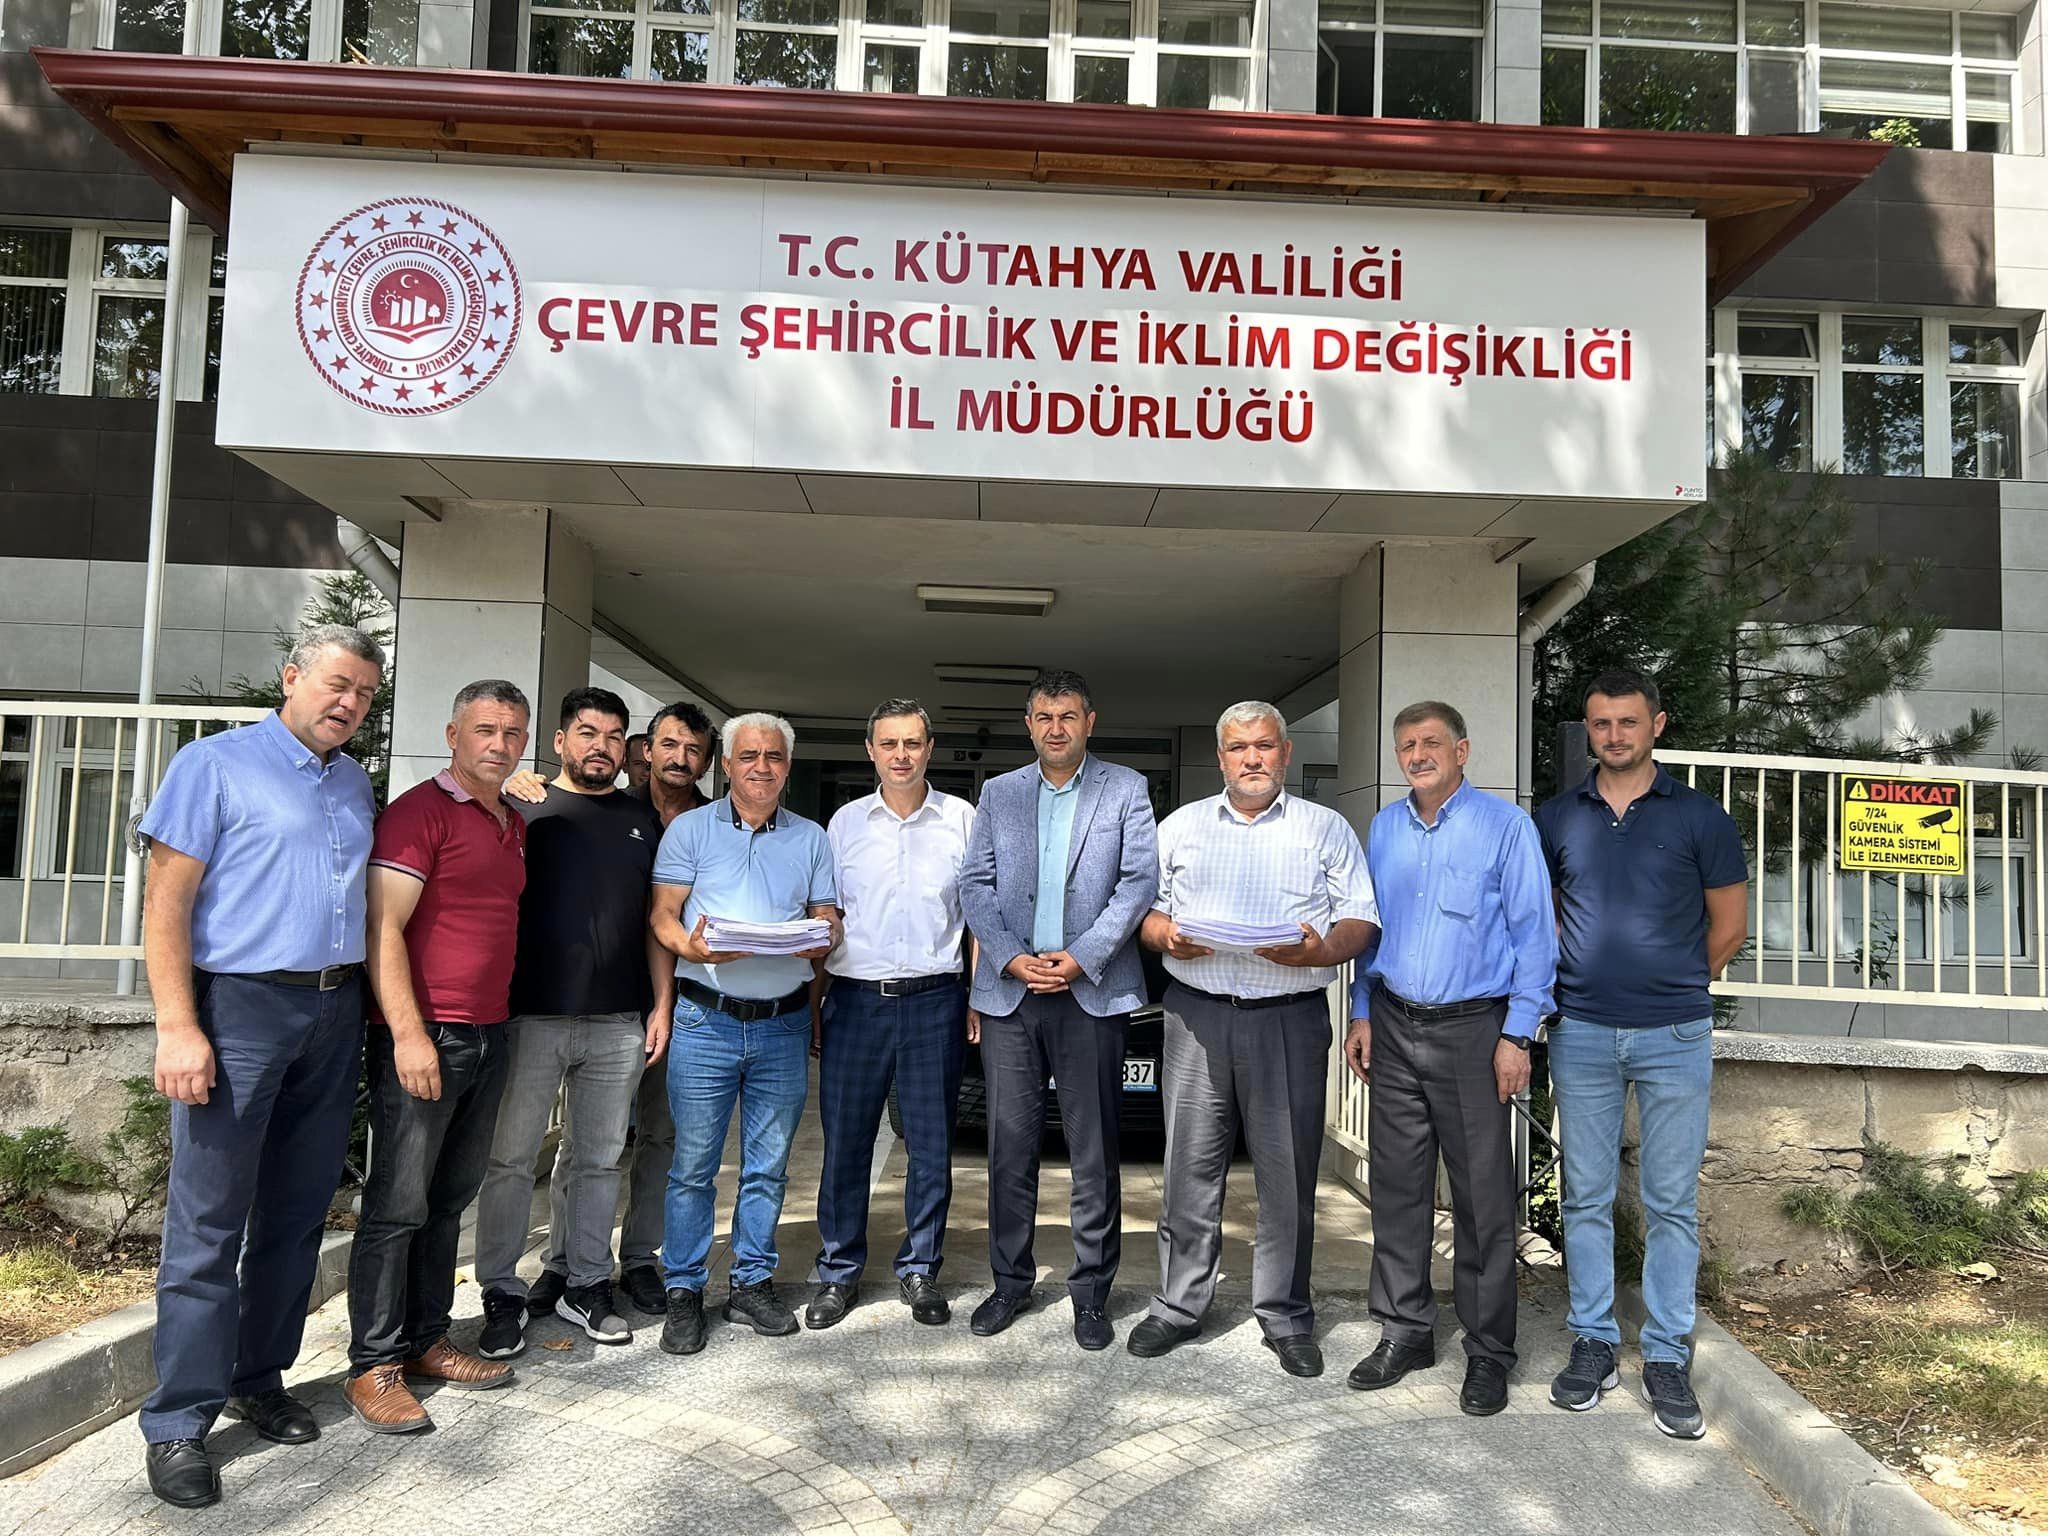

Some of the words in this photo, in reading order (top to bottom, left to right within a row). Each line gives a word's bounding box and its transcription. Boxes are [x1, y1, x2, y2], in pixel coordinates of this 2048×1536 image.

[377, 235, 437, 256] ŞEHİRCİLİK
[436, 243, 452, 259] VE
[447, 250, 474, 282] İKLİM
[780, 233, 874, 279] T.C.
[895, 231, 1156, 291] KÜTAHYA
[1178, 244, 1402, 301] VALİLİĞİ
[334, 274, 358, 345] CUMHURİYETİ
[461, 279, 485, 342] DEĞİŞİKLİĞİ
[352, 342, 393, 375] TÜRKİYE
[415, 340, 468, 376] BAKANLIĞI
[538, 298, 718, 353] ÇEVRE
[740, 299, 1037, 360] ŞEHİRCİLİK
[1051, 319, 1118, 364] VE
[1138, 311, 1290, 370] İKLİM
[1313, 321, 1632, 387] DEĞİŞİKLİĞİ
[890, 375, 934, 430] İL
[957, 379, 1314, 444] MÜDÜRLÜĞÜ
[1870, 780, 1956, 805] DİKKAT
[1849, 819, 1904, 834] GÜVENLİK
[1865, 807, 1888, 820] 7/24
[1849, 836, 1895, 848] KAMERA
[1898, 837, 1940, 850] SİSTEMİ
[1849, 848, 1865, 862] İLE
[1869, 849, 1958, 867] İZLENMEKTEDİR.
